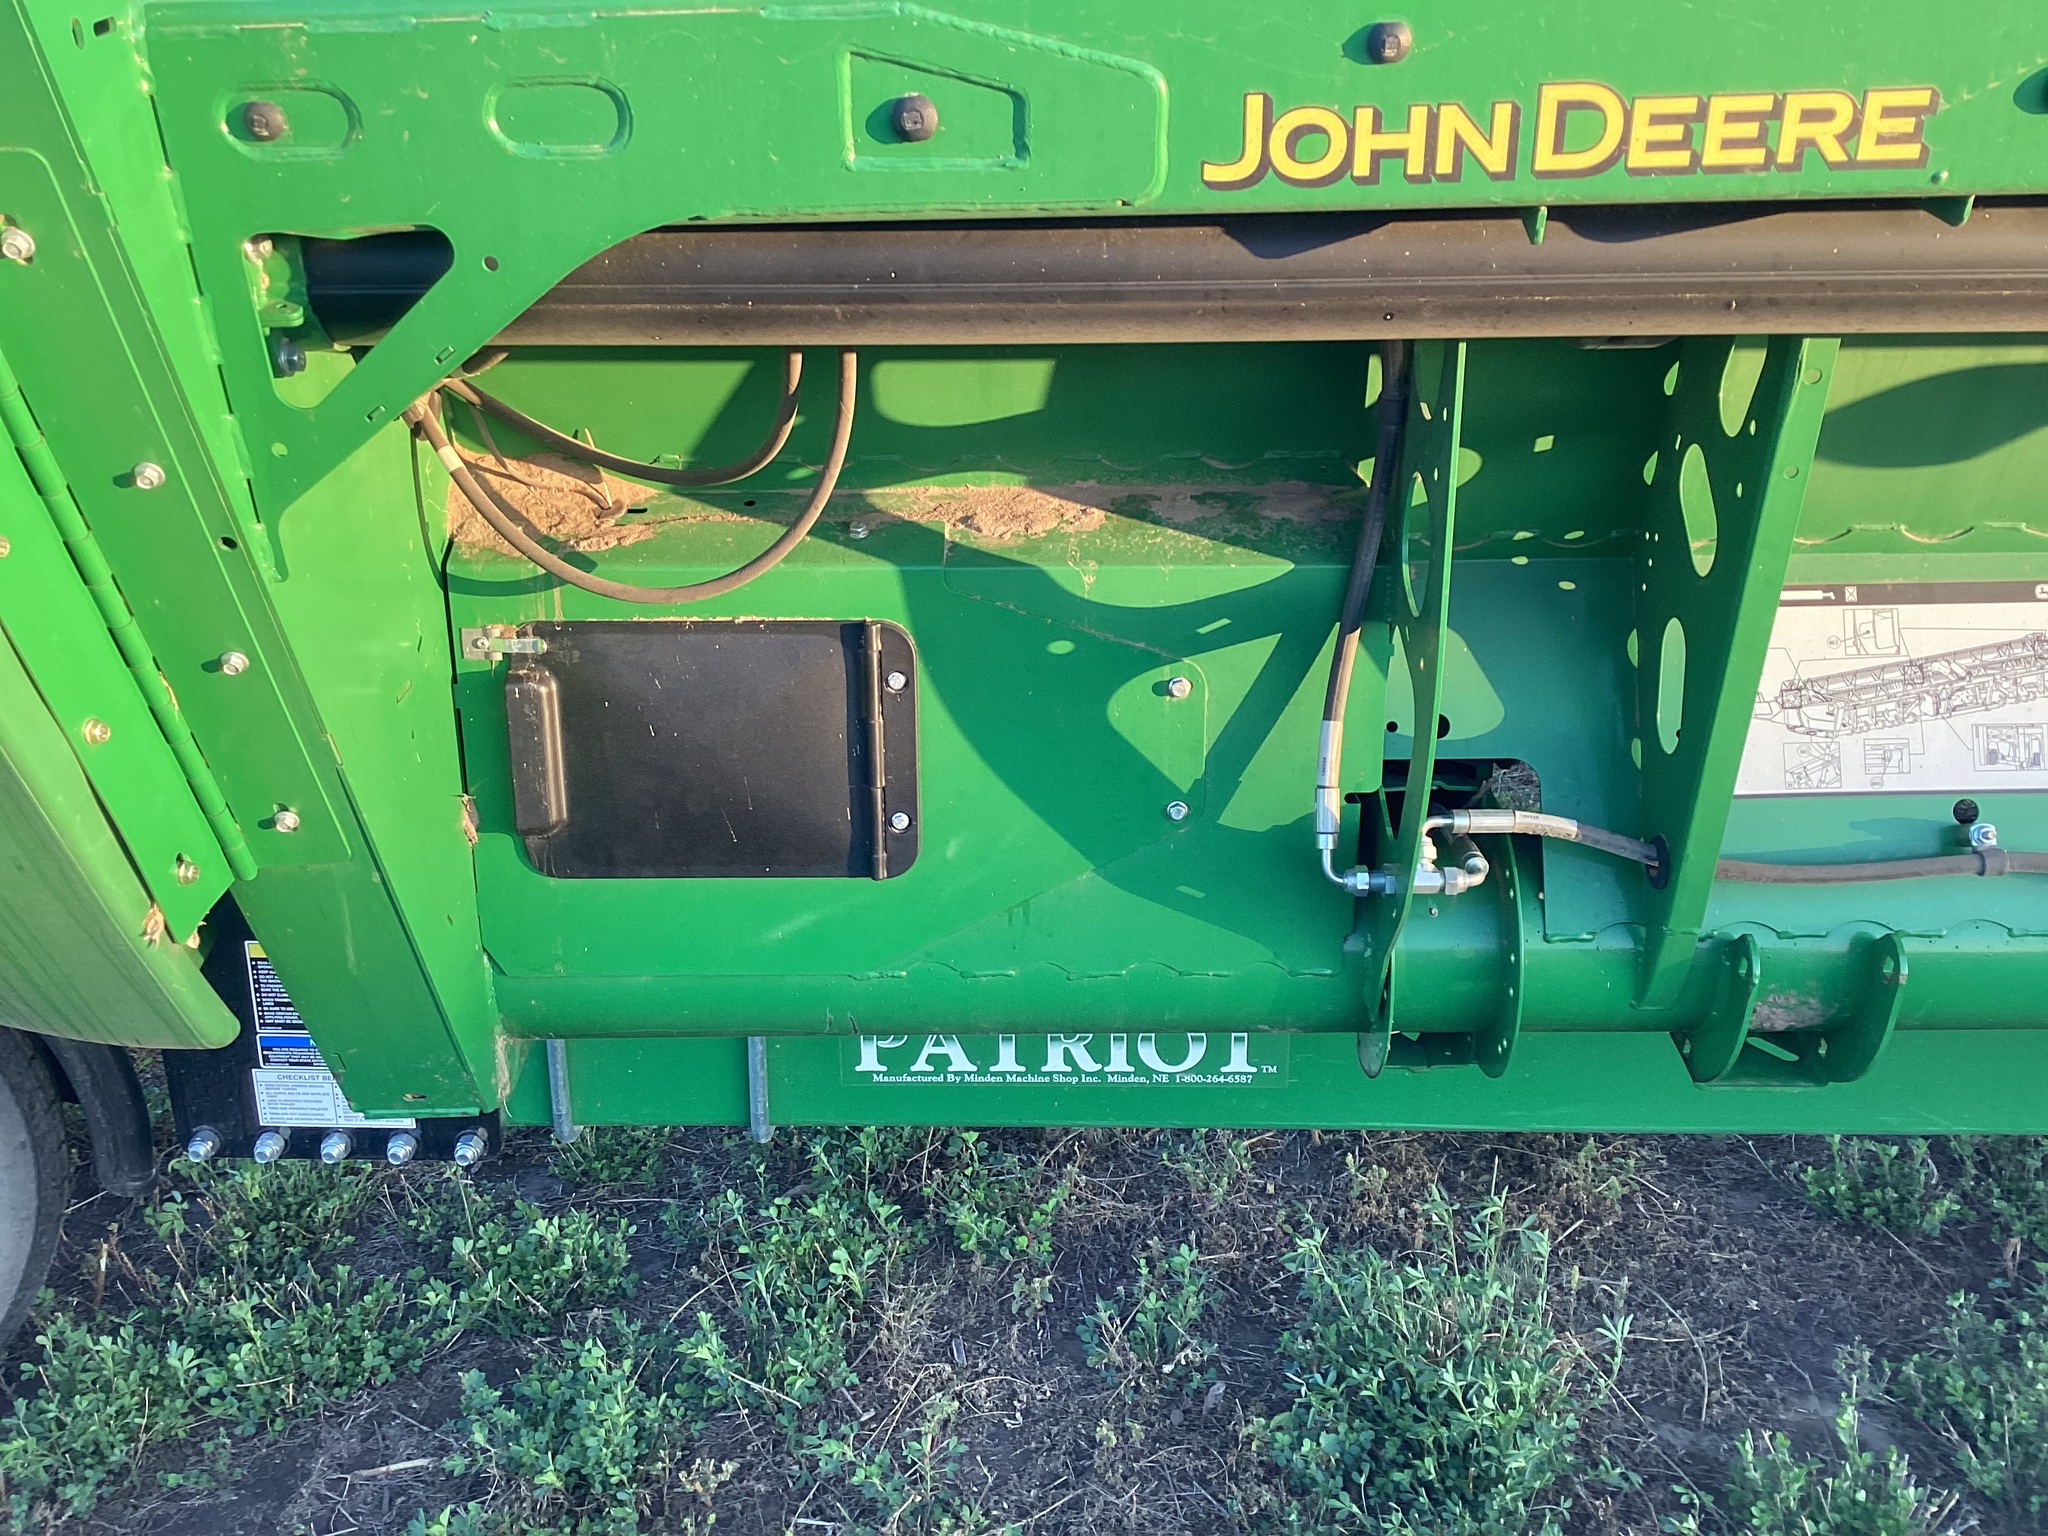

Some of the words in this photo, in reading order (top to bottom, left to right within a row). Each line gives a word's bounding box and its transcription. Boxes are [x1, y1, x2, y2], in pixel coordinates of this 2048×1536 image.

[1201, 92, 1519, 190] JOHN
[1531, 82, 1939, 180] DEERE
[872, 1073, 944, 1083] Manufactured
[947, 1073, 962, 1084] By
[964, 1073, 1003, 1083] Minden
[1006, 1073, 1050, 1083] Machine
[1052, 1073, 1079, 1084] Shop
[1081, 1073, 1102, 1083] Inc.
[1107, 1074, 1150, 1085] Minden,
[1152, 1074, 1170, 1083] NE
[1175, 1074, 1253, 1084] 1-800-264-6587
